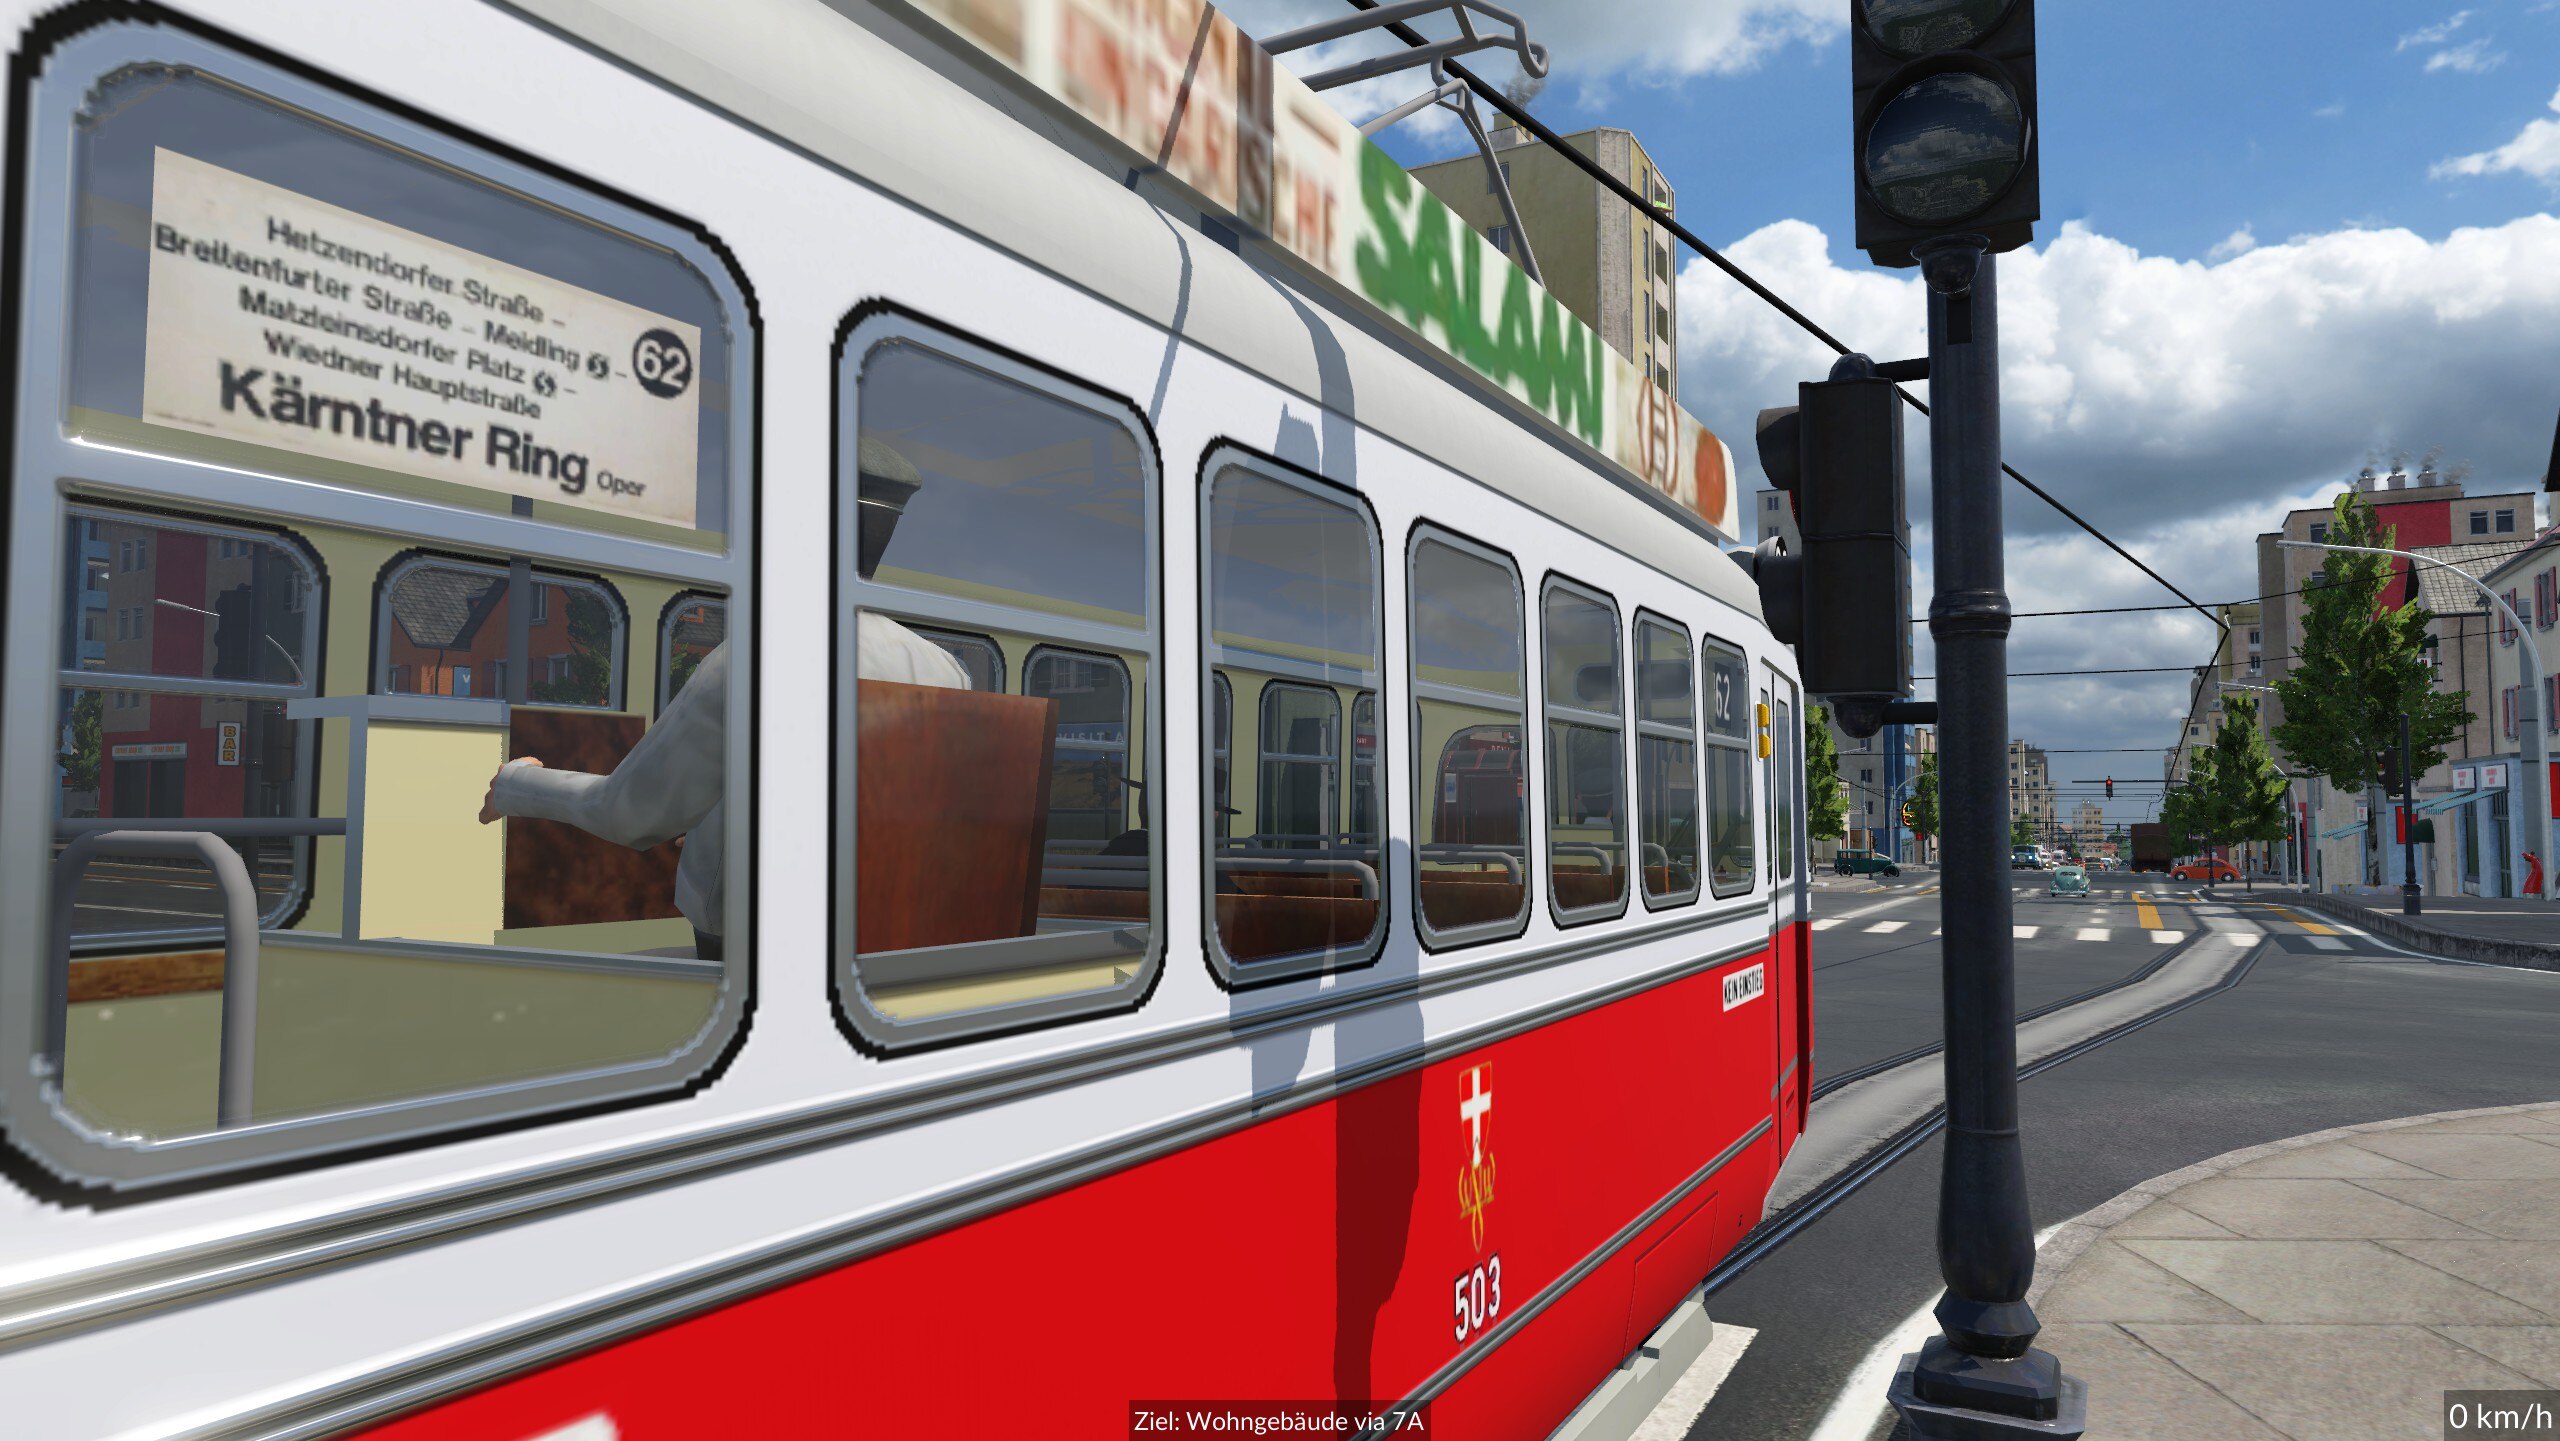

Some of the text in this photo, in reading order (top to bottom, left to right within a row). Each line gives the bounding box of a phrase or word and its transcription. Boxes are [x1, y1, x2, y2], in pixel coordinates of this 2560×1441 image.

[155, 222, 352, 302] Breitenfurter
[363, 283, 453, 330] Straße
[485, 319, 581, 372] Meidling
[267, 215, 454, 295] Hetzendorfer
[464, 279, 544, 323] Straße
[1355, 132, 1604, 451] SALAMI
[238, 285, 458, 365] Matzleinsdorfer
[466, 348, 526, 384] Platz
[262, 328, 542, 420] Wiedner Hauptstraße
[636, 337, 687, 389] 62
[218, 356, 647, 498] Kärntner Ring Oper
[1715, 671, 1730, 721] 62
[223, 725, 236, 762] BAR
[1724, 967, 1763, 1004] KEIN EINSTIEG
[1455, 1253, 1501, 1344] 503
